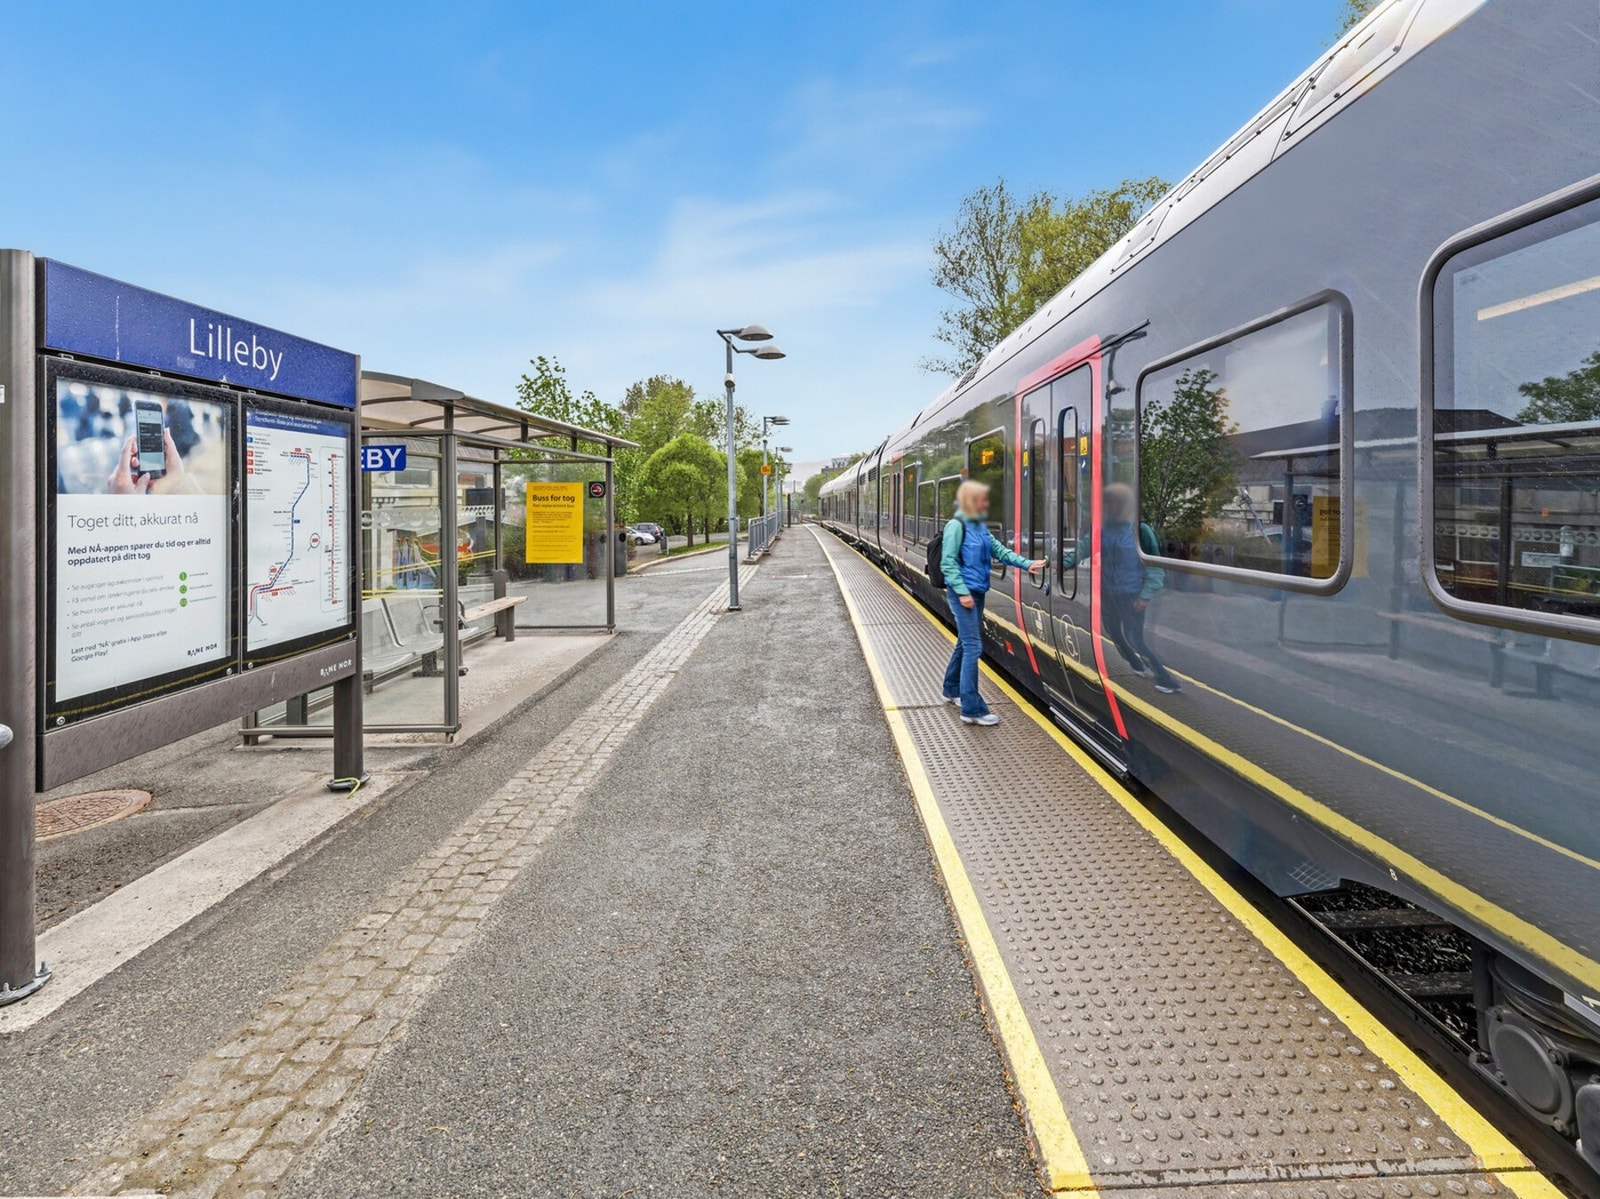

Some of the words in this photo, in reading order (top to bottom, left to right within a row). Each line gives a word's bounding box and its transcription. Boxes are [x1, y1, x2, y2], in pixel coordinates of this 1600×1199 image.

[190, 318, 283, 381] Lilleby
[361, 448, 402, 469] BY
[67, 514, 109, 531] Toget
[113, 513, 137, 528] ditt,
[140, 513, 181, 526] akkurat
[185, 512, 198, 524] nå
[67, 546, 87, 555] Med
[89, 543, 129, 554] NÅ-appen
[130, 543, 153, 552] sparer
[155, 540, 164, 548] du
[166, 539, 175, 547] tid
[177, 540, 186, 548] og
[195, 537, 211, 545] alltid
[67, 554, 110, 566] oppdatert
[111, 555, 121, 563] på
[123, 553, 137, 561] ditt
[138, 552, 151, 561] tog
[71, 654, 94, 663] Google
[320, 664, 337, 677] BANE
[338, 659, 352, 669] NOR
